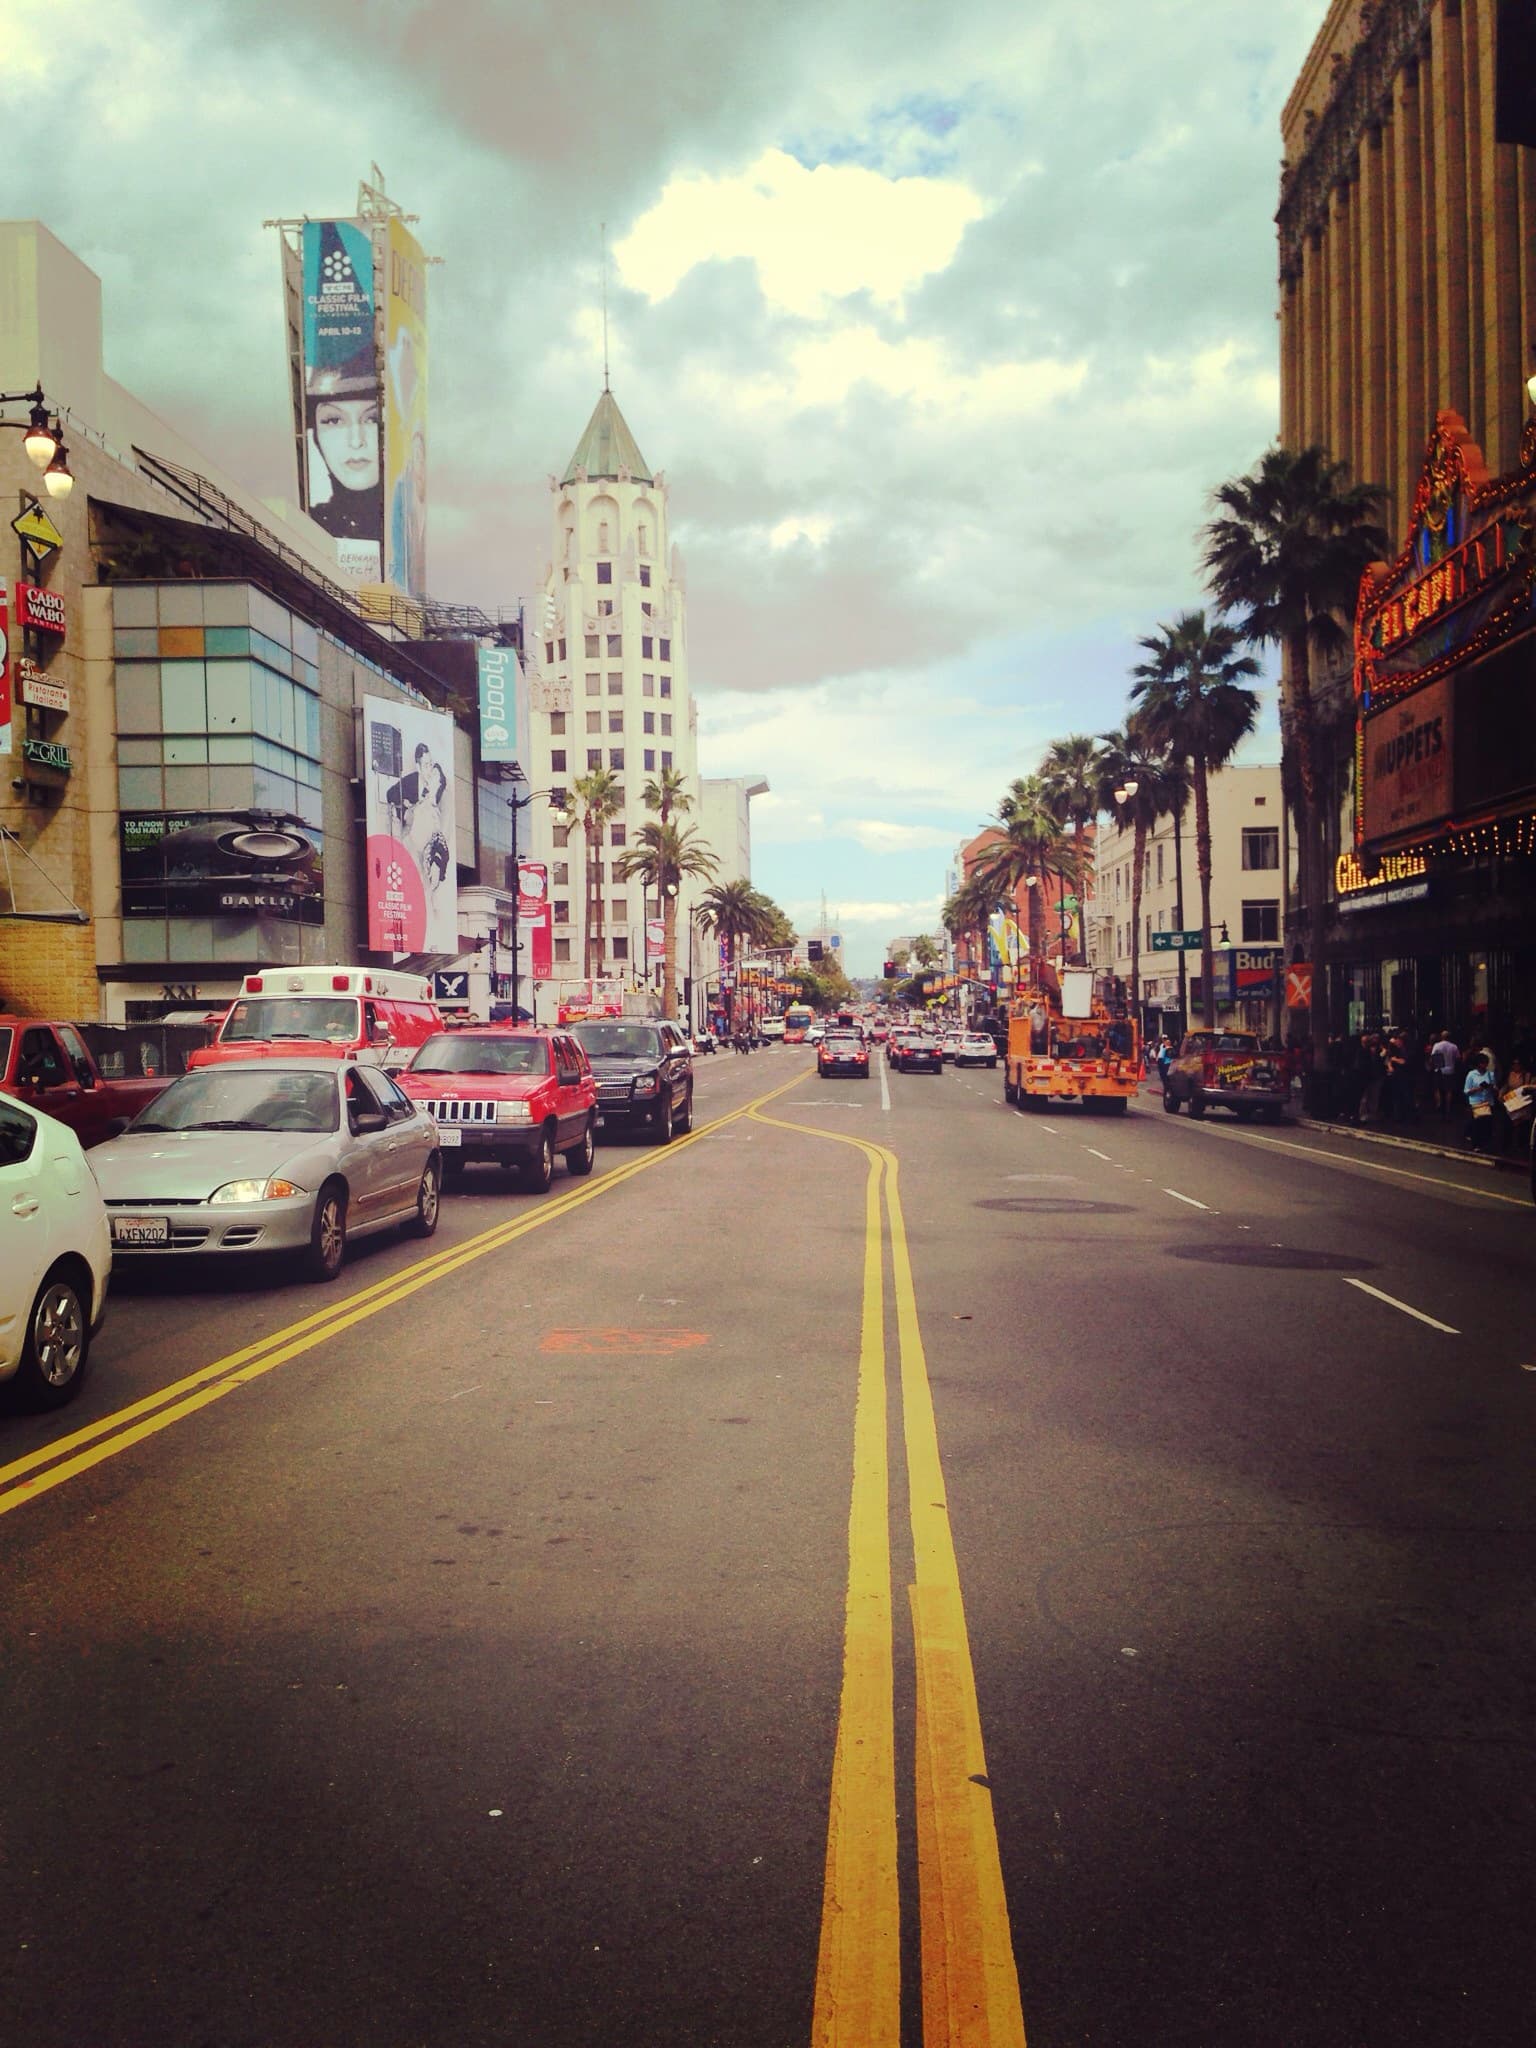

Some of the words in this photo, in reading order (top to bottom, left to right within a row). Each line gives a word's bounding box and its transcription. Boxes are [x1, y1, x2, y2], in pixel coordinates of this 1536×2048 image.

[308, 295, 346, 304] CLASSIC
[347, 294, 369, 303] FILM
[318, 303, 360, 312] FESTIVAL
[318, 327, 341, 336] APRIL
[27, 588, 64, 611] CABO
[28, 602, 65, 624] WABO
[27, 616, 65, 632] CANTINA
[28, 682, 68, 700] Ristorante
[481, 649, 508, 721] booty
[39, 744, 73, 764] GRILL
[1374, 716, 1442, 778] MUPPETS
[1336, 854, 1427, 894] Ghirdelli
[378, 901, 400, 910] CLASSIC
[383, 910, 407, 920] FESTIVAL
[1235, 951, 1274, 970] Bud
[163, 984, 197, 1000] XXI
